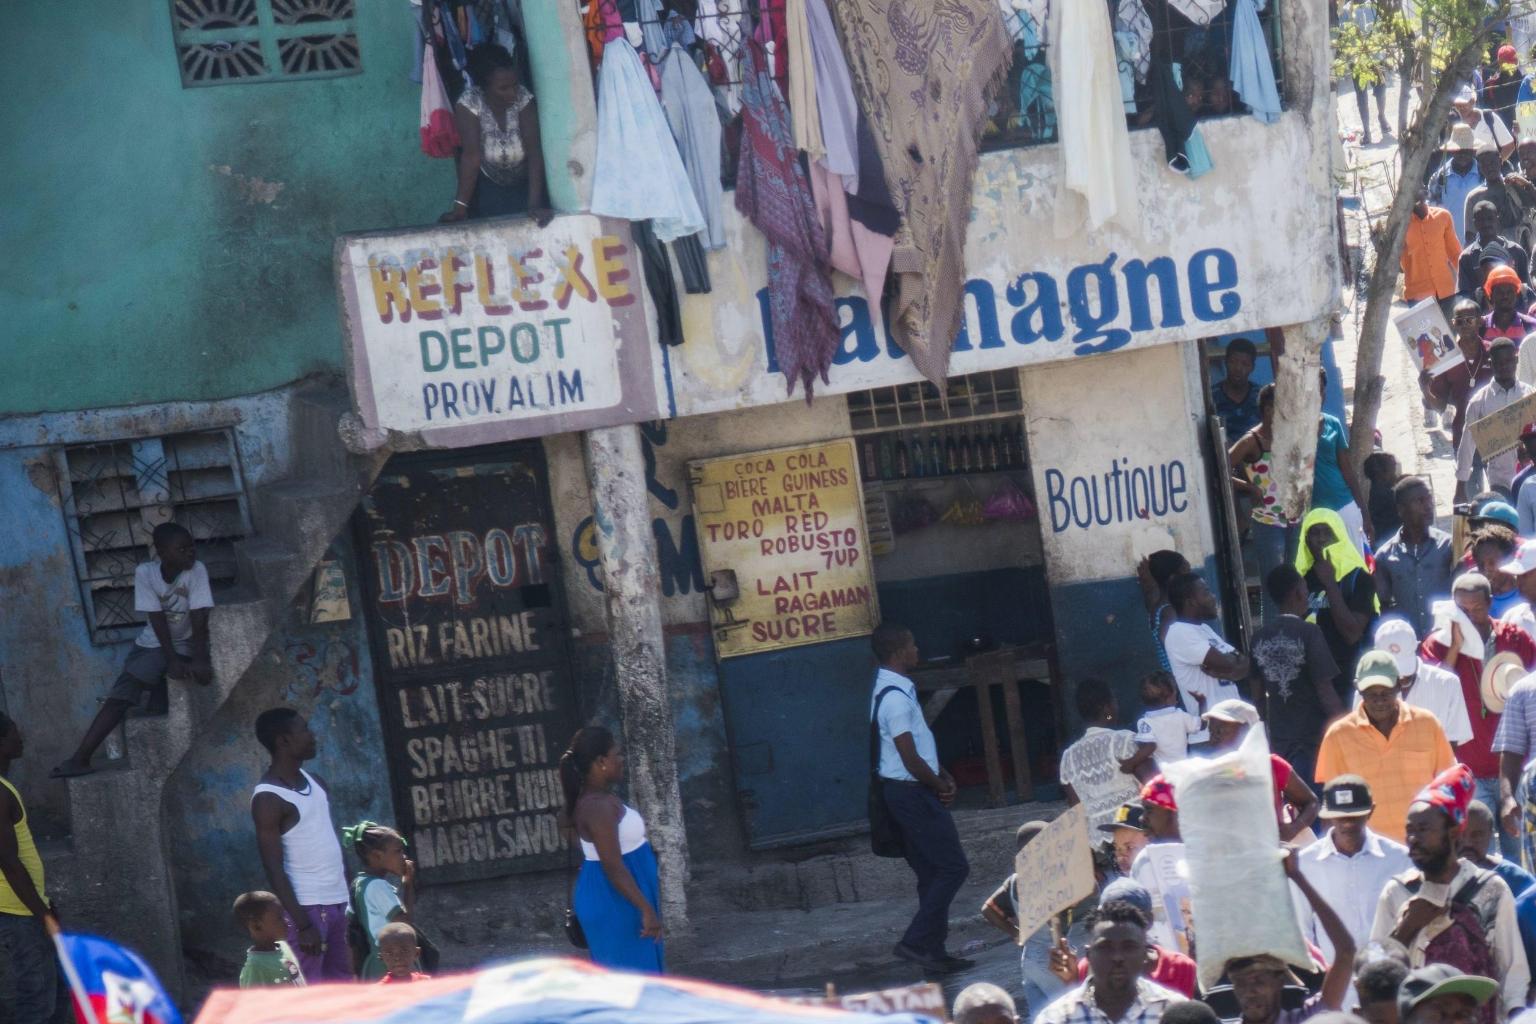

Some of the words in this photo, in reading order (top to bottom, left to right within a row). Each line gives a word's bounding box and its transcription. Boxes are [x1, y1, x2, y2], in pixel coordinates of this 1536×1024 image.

[368, 235, 636, 324] REFLEXE
[419, 318, 571, 373] DEPOT
[507, 368, 585, 411] ALIM
[734, 459, 776, 475] COCA
[786, 452, 828, 470] COLA
[783, 468, 849, 492] GUINESS
[1045, 457, 1188, 533] Boutique
[752, 492, 820, 517] MALTA
[706, 518, 764, 543] TORO
[761, 527, 857, 556] ROBUSTO
[371, 522, 548, 605] DEPOT
[820, 548, 859, 570] 7UP
[757, 571, 818, 596] LAIT
[775, 585, 871, 616] RAGAMAN
[386, 624, 433, 669] RIZ
[438, 611, 540, 660] FARINE
[752, 612, 837, 642] SUCRE
[411, 774, 515, 825] BEURRE
